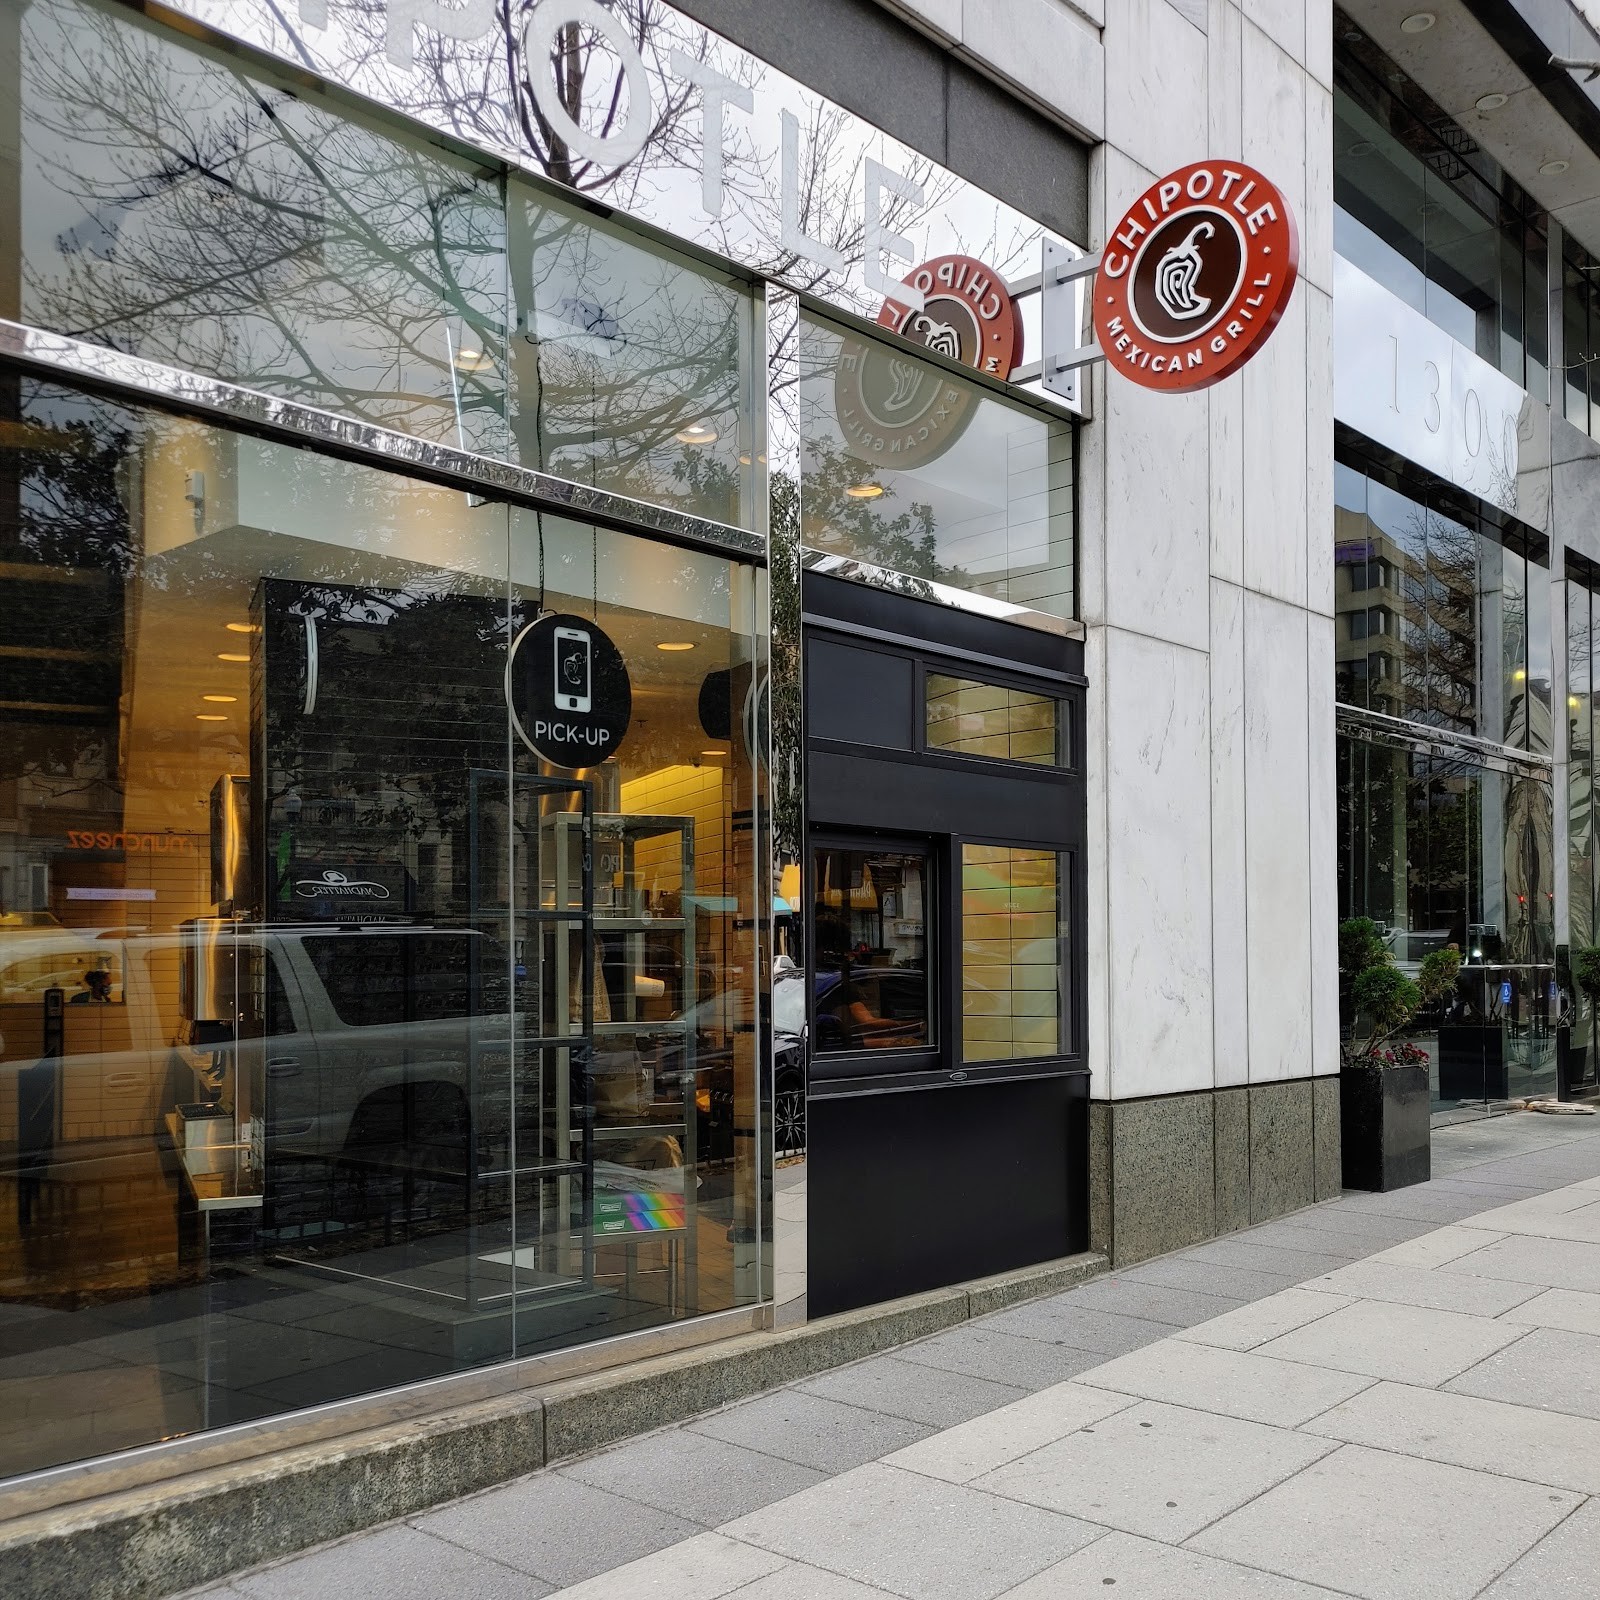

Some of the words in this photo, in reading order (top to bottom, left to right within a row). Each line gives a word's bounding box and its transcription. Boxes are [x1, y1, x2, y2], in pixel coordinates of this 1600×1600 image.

[290, 0, 924, 312] OTLE
[1104, 169, 1278, 279] CHIPOTLE
[1106, 316, 1204, 373] MEXICAN
[1210, 272, 1272, 353] GRILL
[1388, 333, 1518, 481] 1300
[535, 720, 610, 746] PICK-UP
